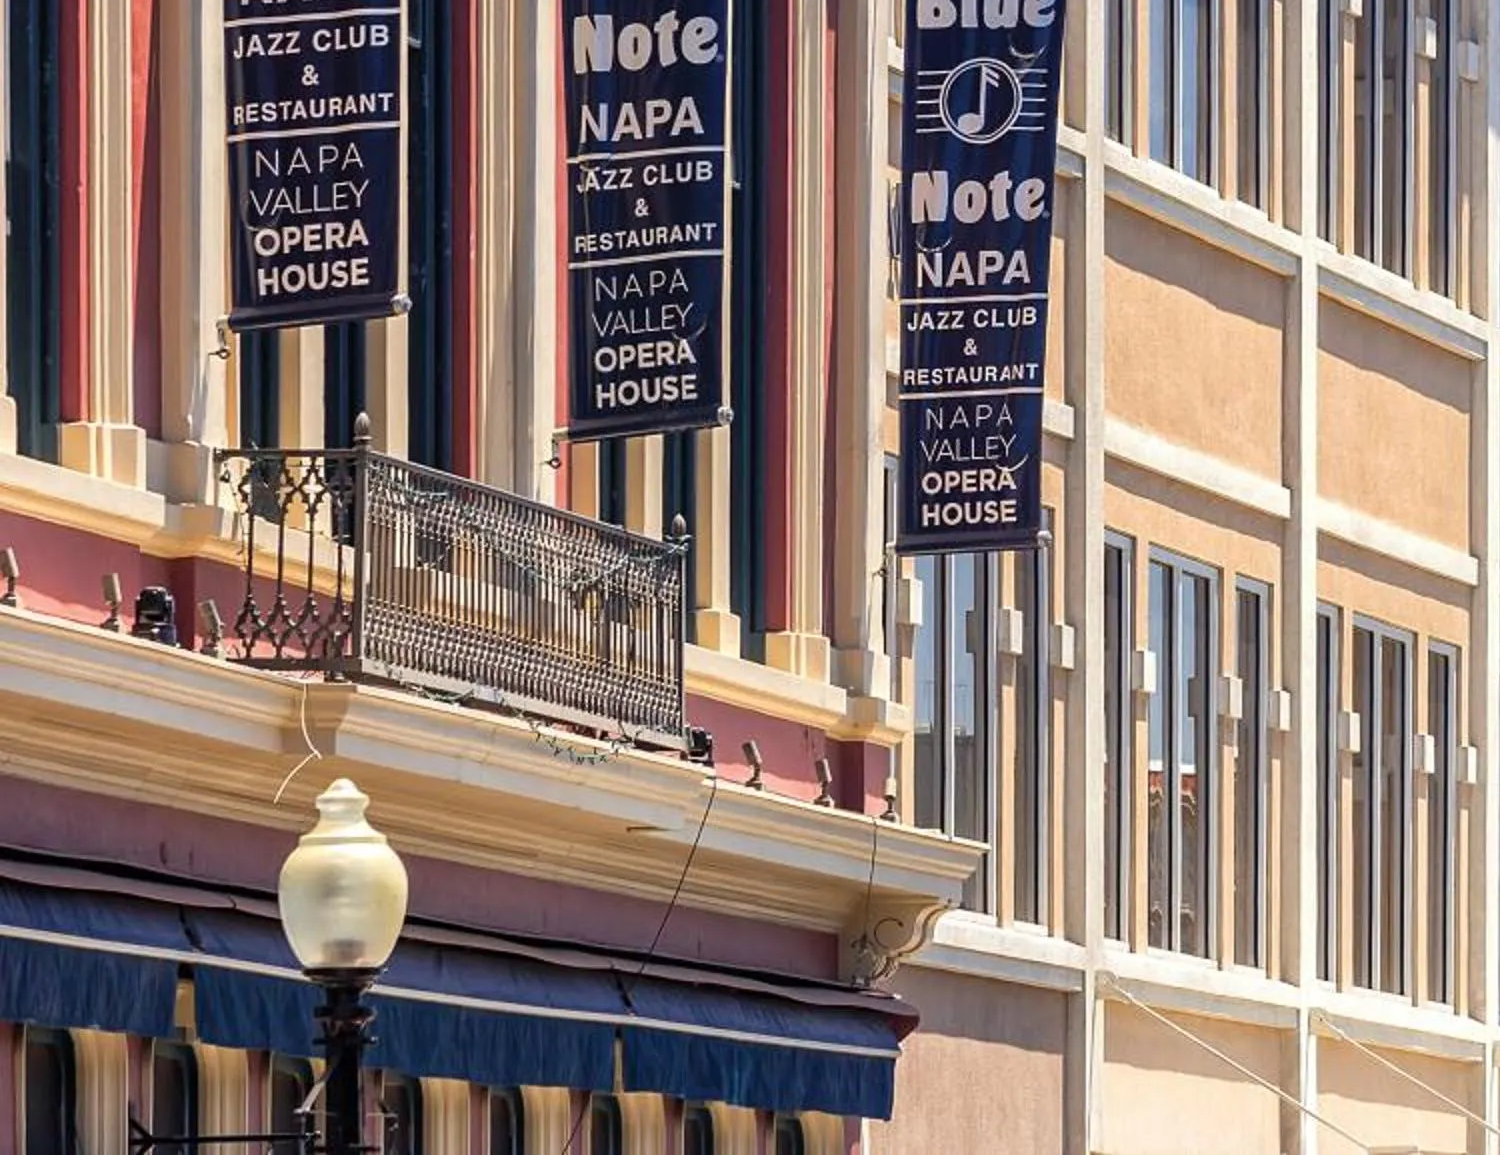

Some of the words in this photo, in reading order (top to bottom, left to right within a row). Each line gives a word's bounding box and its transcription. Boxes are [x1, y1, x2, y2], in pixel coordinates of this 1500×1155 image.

[233, 30, 301, 59] JAZZ
[312, 24, 389, 53] CLUB
[572, 10, 719, 74] Note
[302, 65, 320, 86] &
[233, 93, 394, 125] RESTAURANT
[579, 96, 704, 143] NAPA
[254, 143, 364, 178] NAPA
[576, 167, 633, 194] JAZZ
[643, 161, 713, 185] CLUB
[250, 180, 369, 216] VALLEY
[634, 198, 649, 217] &
[911, 170, 1046, 224] Note
[254, 219, 369, 256] OPERA
[574, 223, 717, 254] RESTAURANT
[258, 258, 370, 296] HOUSE
[595, 268, 688, 302] NAPA
[916, 249, 1030, 288] NAPA
[592, 302, 694, 337] VALLEY
[907, 310, 965, 331] JAZZ
[973, 306, 1037, 328] CLUB
[594, 339, 696, 374] OPERA
[964, 338, 977, 357] &
[595, 374, 697, 409] HOUSE
[903, 363, 1039, 386] RESTAURANT
[925, 403, 1013, 430] NAPA
[920, 434, 1017, 462] VALLEY
[921, 468, 1017, 495] OPERA
[921, 500, 1017, 527] HOUSE
